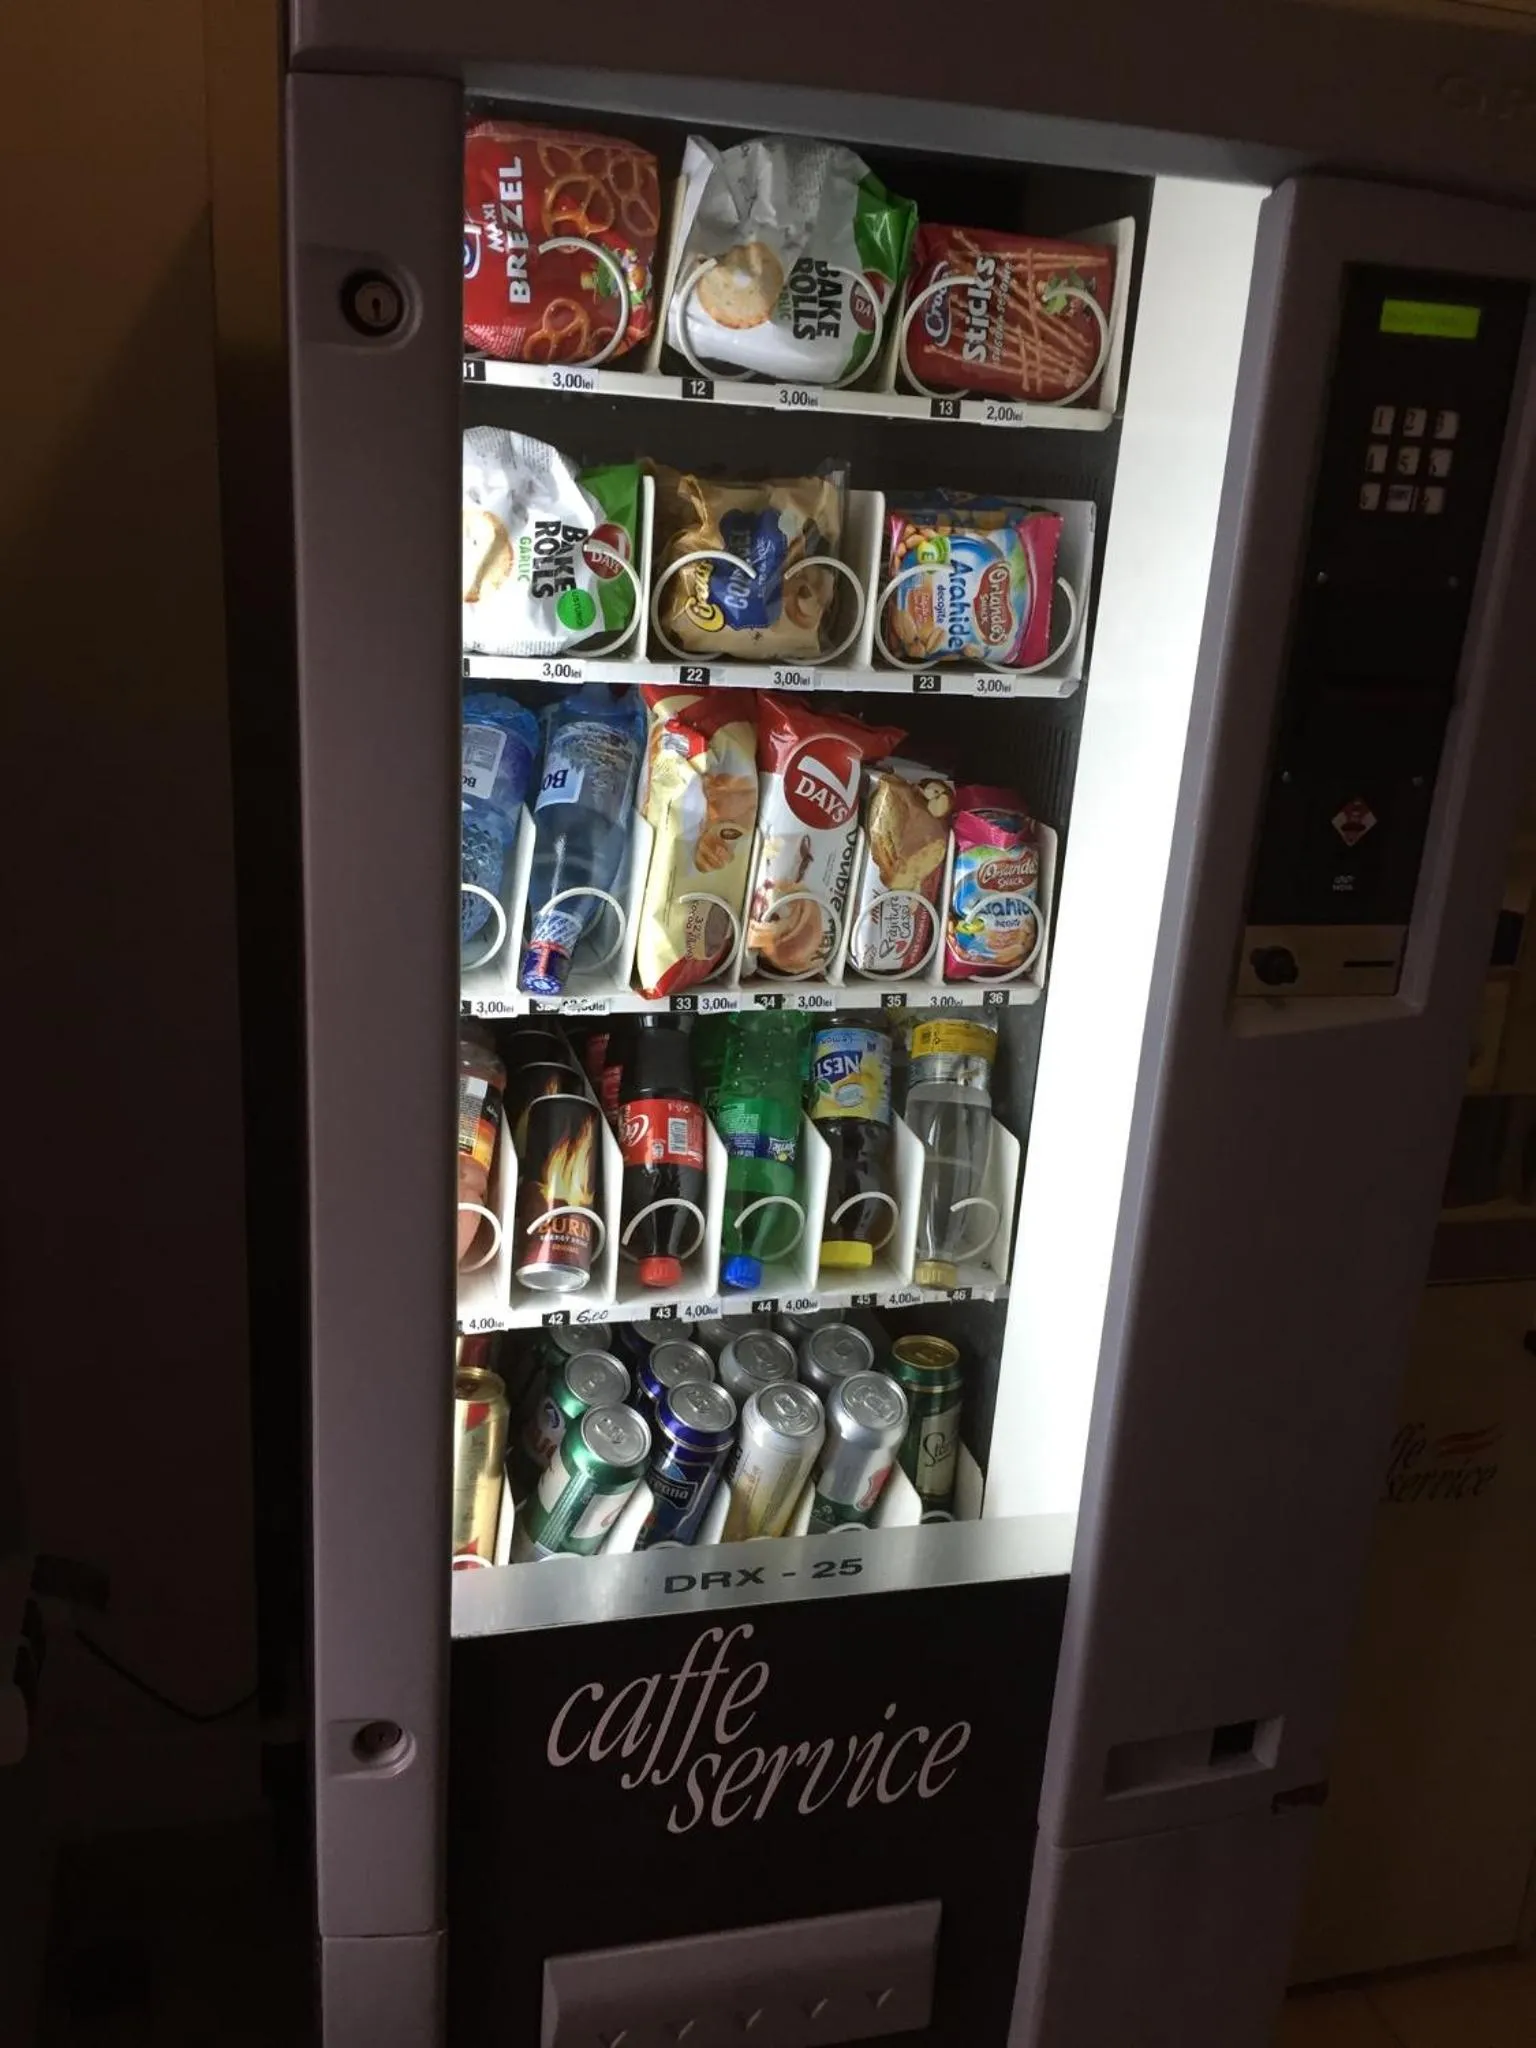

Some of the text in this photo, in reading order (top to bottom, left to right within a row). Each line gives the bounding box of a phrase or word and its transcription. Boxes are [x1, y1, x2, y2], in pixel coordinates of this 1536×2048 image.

[480, 203, 507, 254] MAXI
[498, 155, 532, 304] BREZEL
[814, 260, 843, 341] BAKE
[962, 255, 998, 364] Sticks
[690, 381, 706, 395] 12
[938, 401, 954, 416] 13
[517, 536, 532, 582] GARLIC
[531, 520, 562, 599] ROLLS
[554, 524, 589, 592] BAKE
[948, 559, 974, 650] Arahide
[686, 669, 703, 682] 22
[918, 676, 935, 689] 23
[795, 774, 849, 823] DAYS
[797, 755, 862, 803] 7
[676, 997, 692, 1010] 33
[886, 994, 902, 1007] 35
[988, 992, 1004, 1004] 36
[548, 1313, 564, 1326] 42
[656, 1306, 672, 1319] 43
[663, 1567, 765, 1595] DRX
[811, 1558, 863, 1579] 25
[547, 1623, 770, 1790] caffe
[667, 1703, 972, 1834] service
